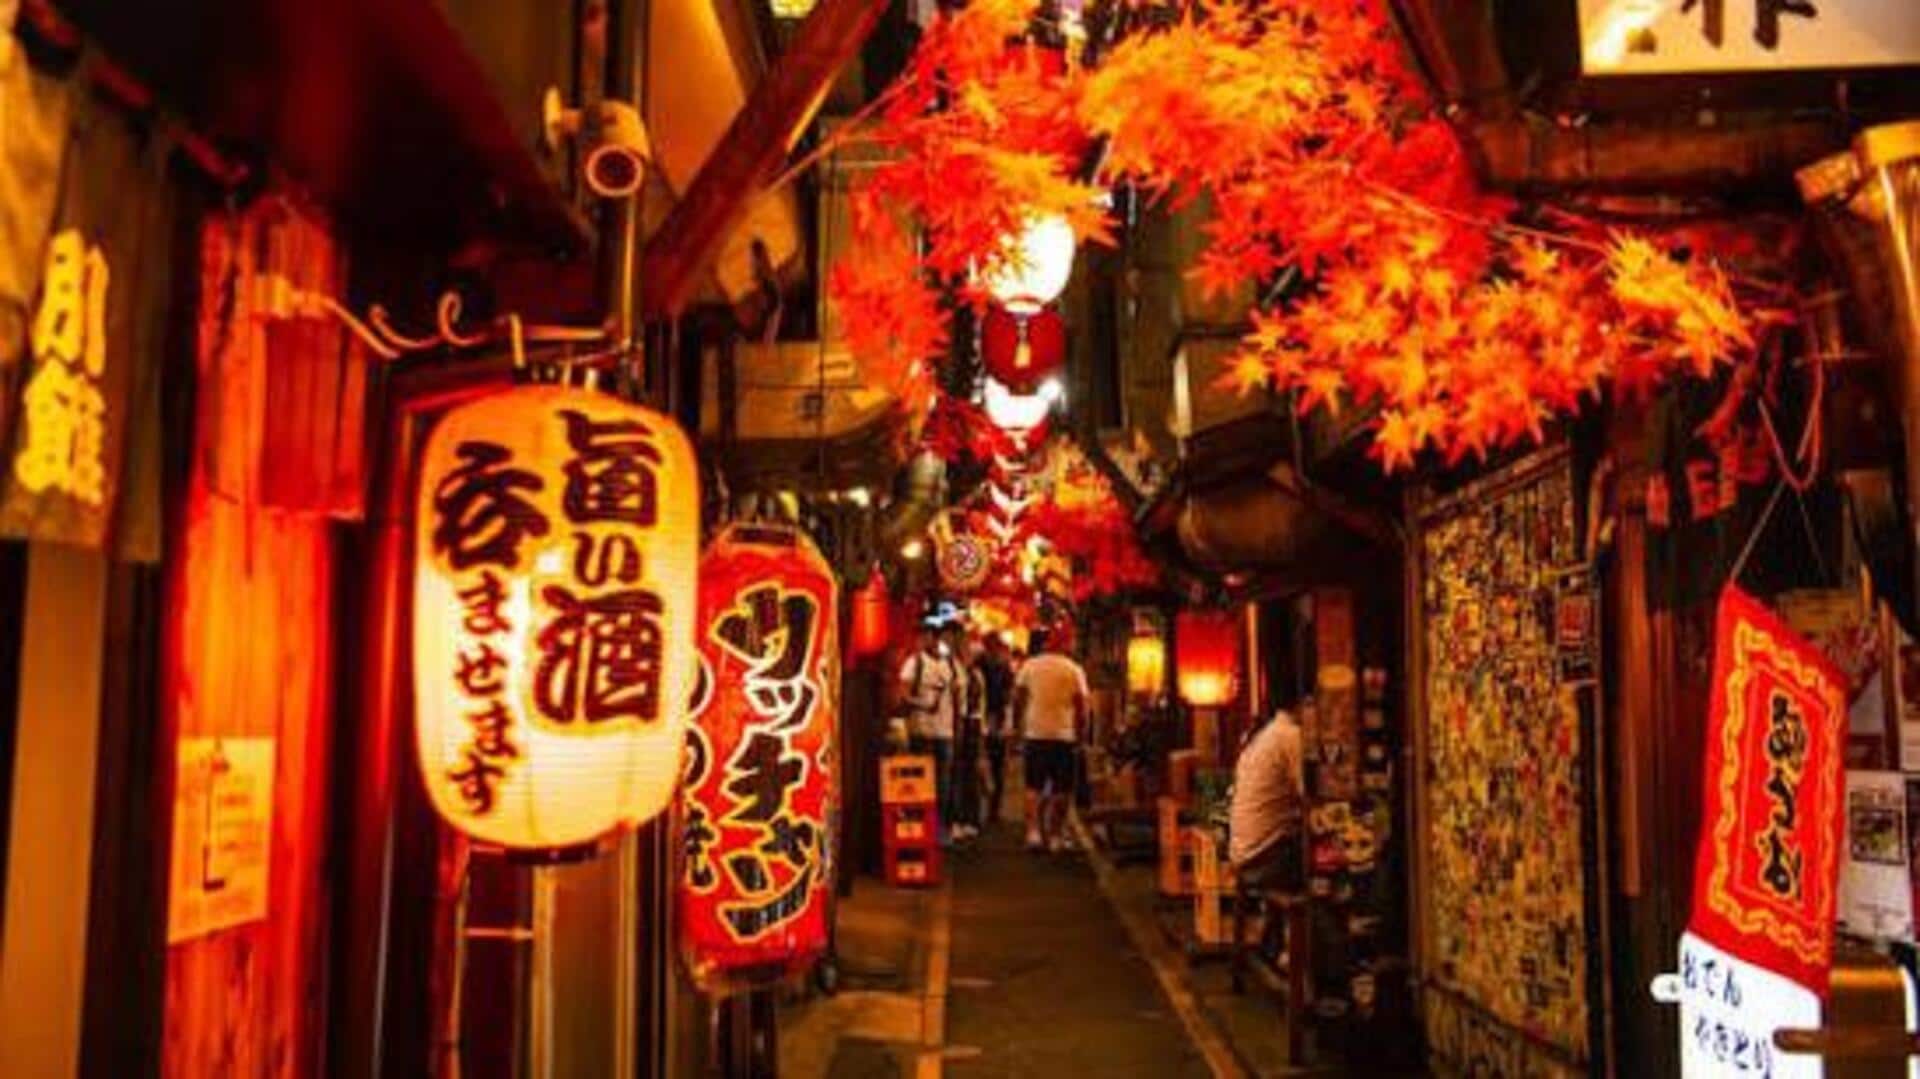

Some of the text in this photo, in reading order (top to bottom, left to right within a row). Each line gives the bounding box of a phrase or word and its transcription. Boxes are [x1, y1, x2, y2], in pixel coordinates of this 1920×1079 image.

[533, 408, 665, 724] 旨い酒
[711, 580, 820, 944] ウッチャン
